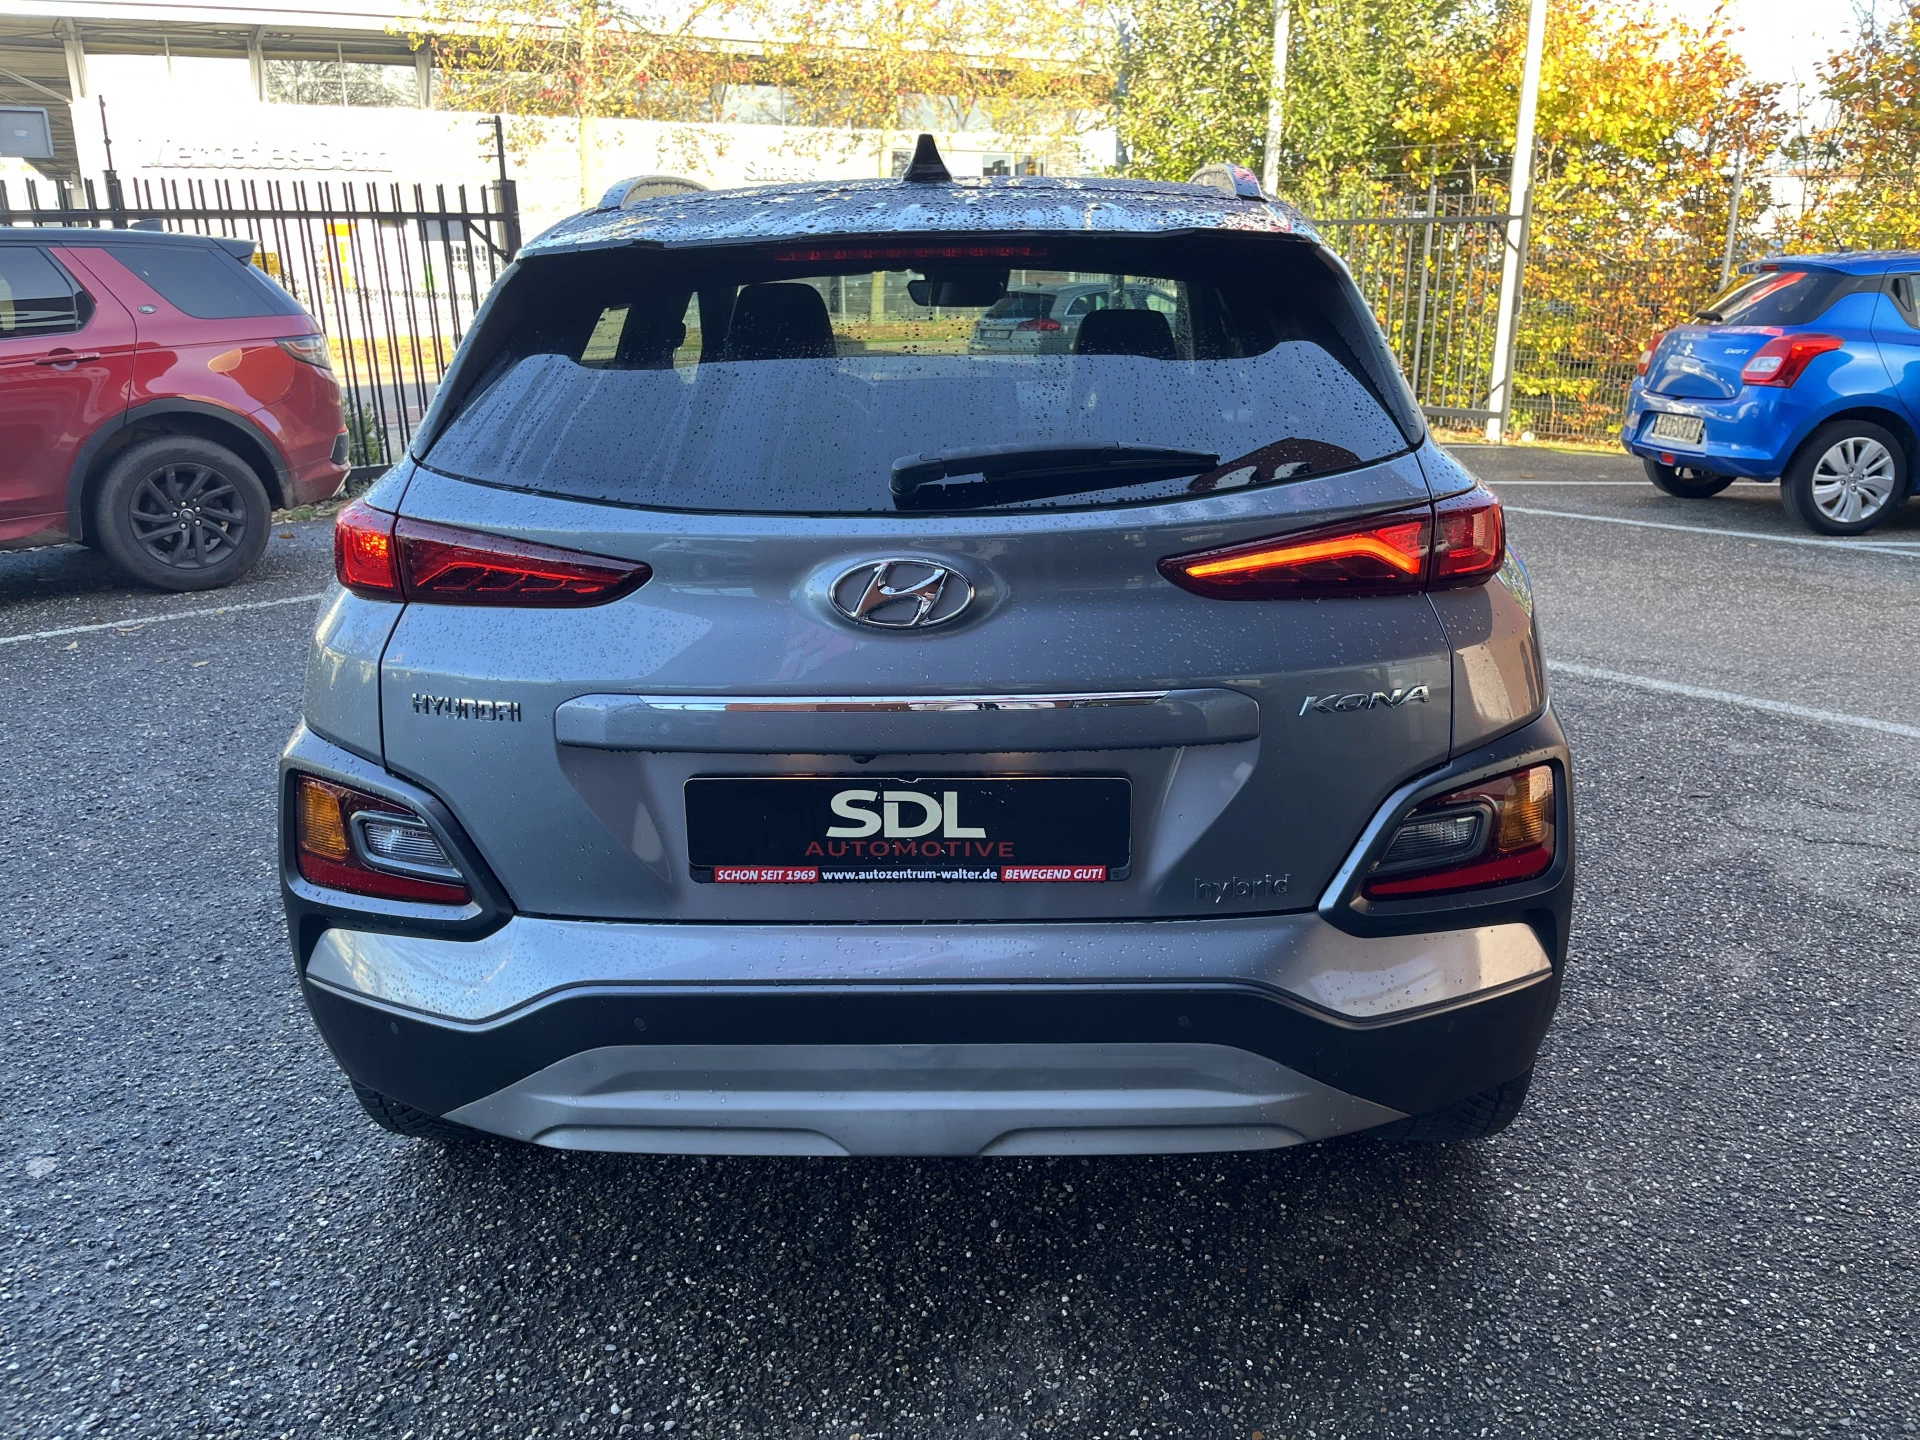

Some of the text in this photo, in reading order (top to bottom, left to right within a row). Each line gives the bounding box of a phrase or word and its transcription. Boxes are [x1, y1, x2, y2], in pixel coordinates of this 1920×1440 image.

[411, 693, 523, 723] HYUNDAI
[1298, 684, 1430, 716] KONA
[825, 789, 987, 839] SDL
[804, 840, 1015, 858] AUTOMOTIVE
[717, 869, 816, 881] SCHON SEIT 1969
[821, 868, 998, 881] www.autozentrum-walter.de
[1004, 868, 1103, 880] BEWEGEND GUT!
[1194, 873, 1292, 904] hybrid
